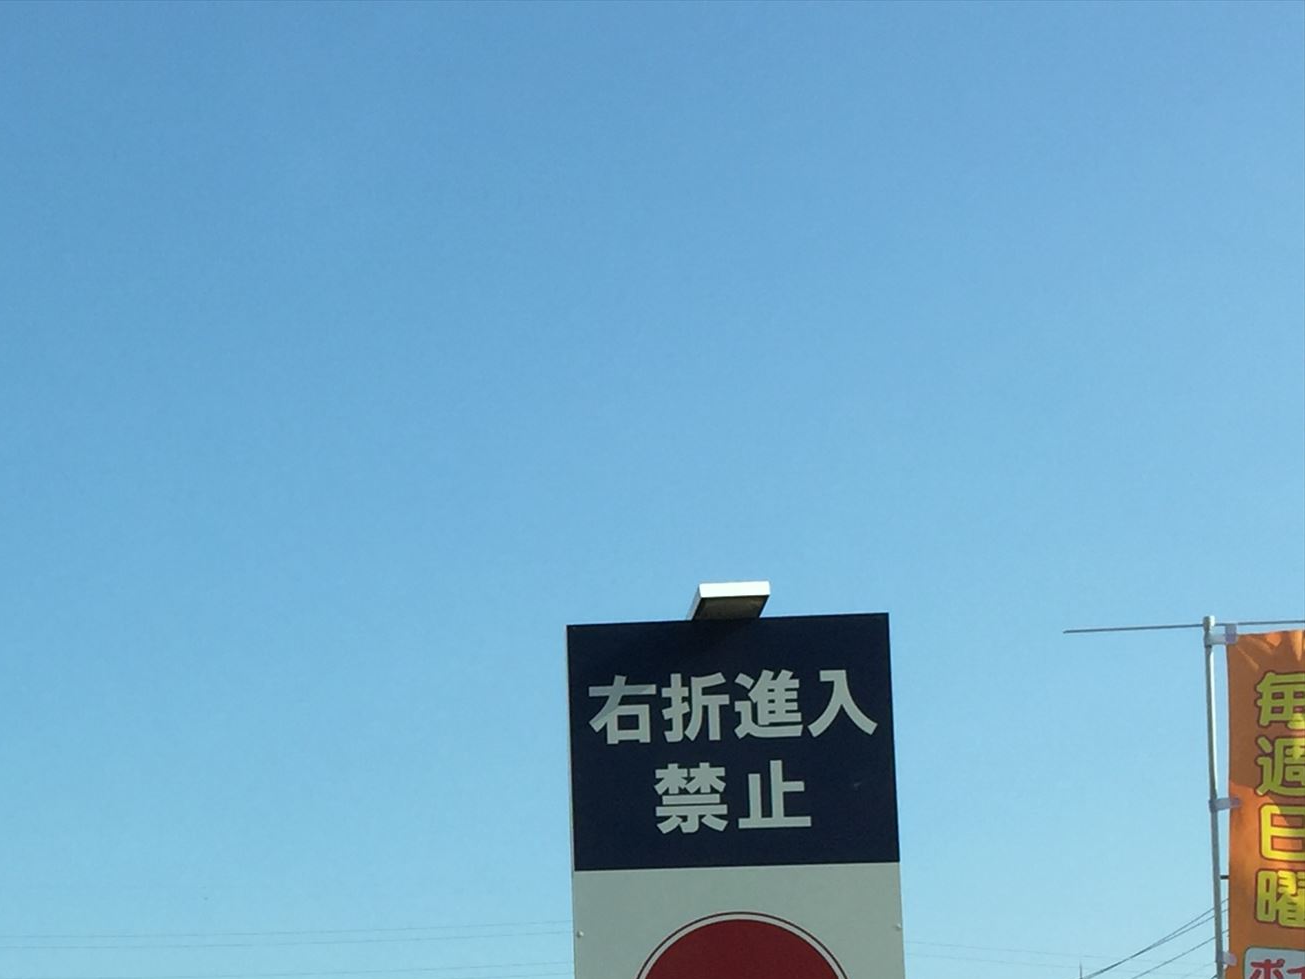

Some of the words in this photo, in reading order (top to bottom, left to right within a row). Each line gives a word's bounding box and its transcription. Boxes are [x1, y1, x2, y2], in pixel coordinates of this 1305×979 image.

[588, 669, 878, 744] 右折進入
[654, 760, 812, 834] 禁止
